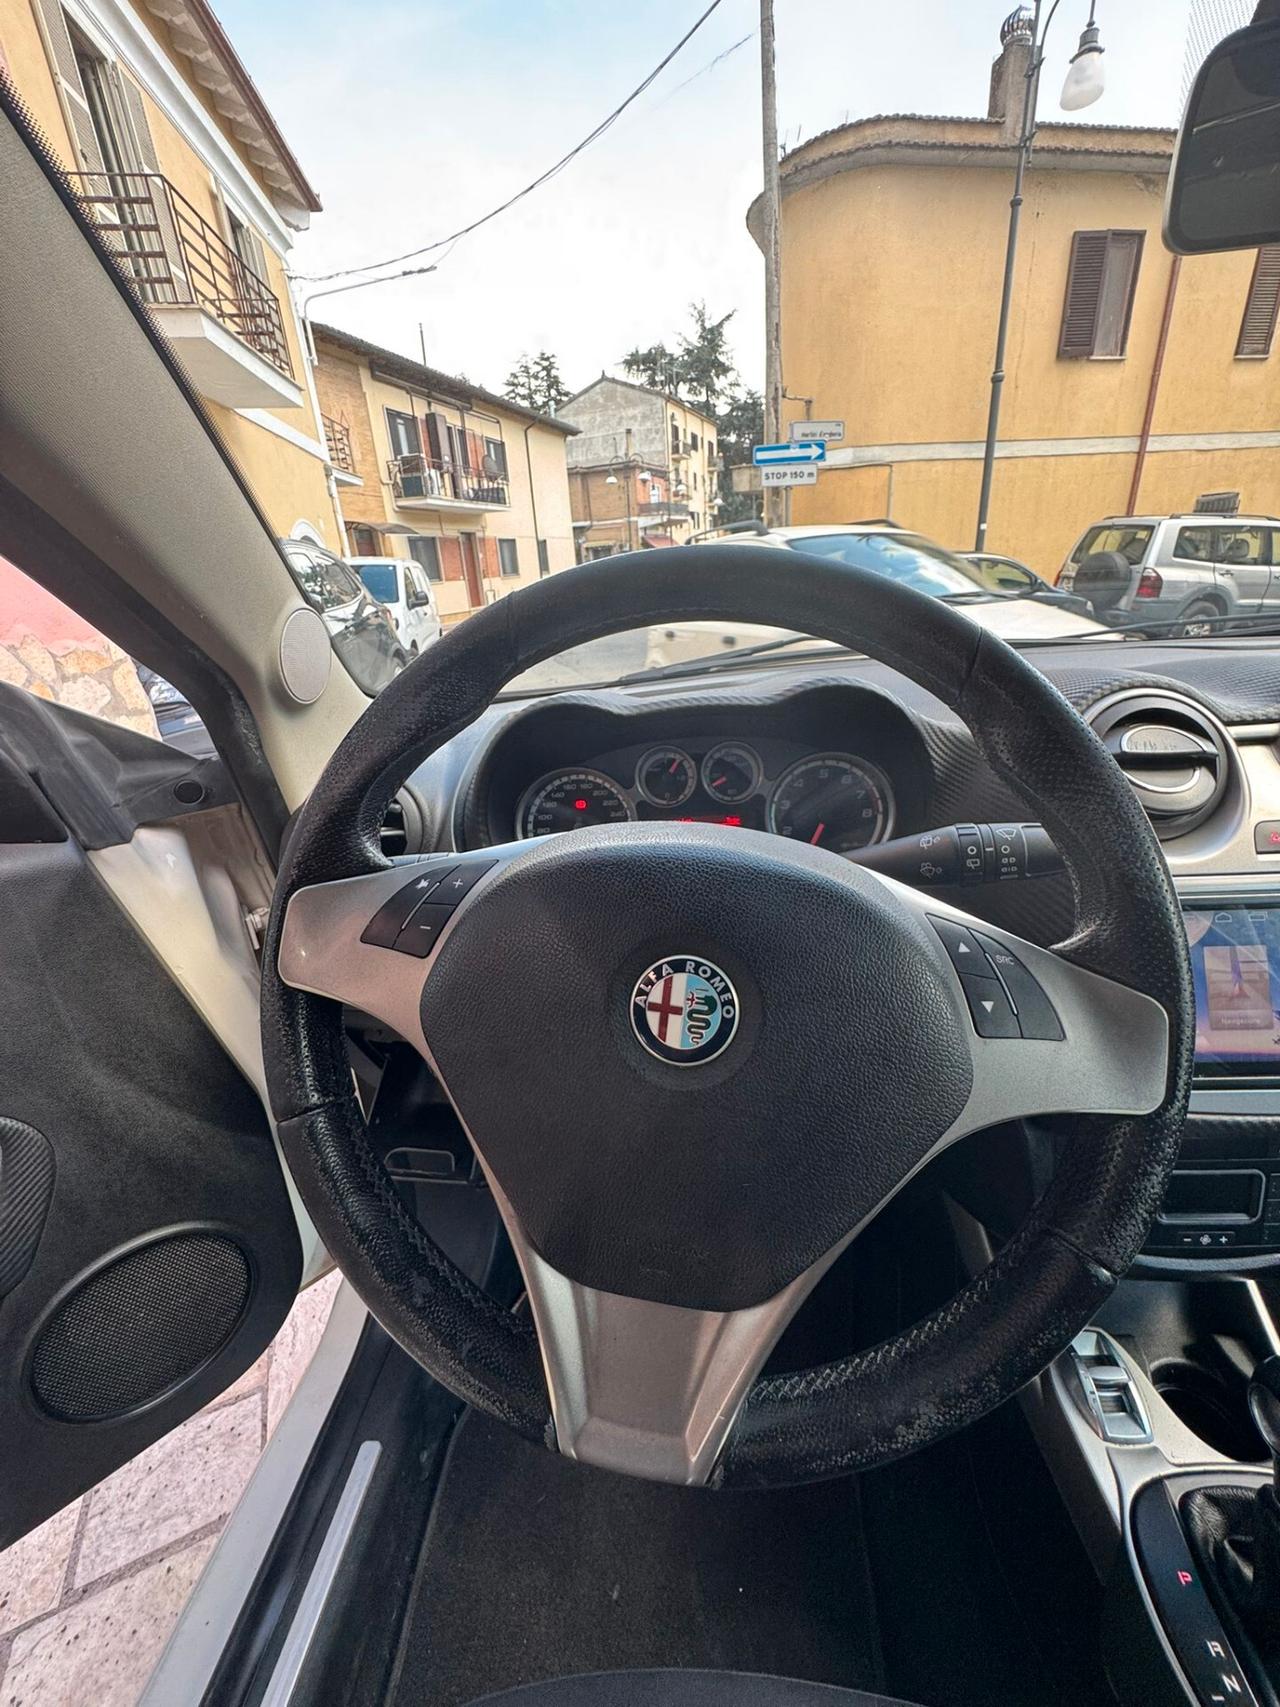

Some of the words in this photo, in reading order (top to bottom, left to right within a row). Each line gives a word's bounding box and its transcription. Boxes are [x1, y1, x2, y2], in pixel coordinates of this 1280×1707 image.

[764, 471, 788, 480] STOP
[790, 471, 805, 479] 150
[819, 769, 829, 778] 5
[856, 790, 866, 799] 7
[780, 800, 791, 810] 3
[782, 826, 793, 835] 2
[995, 954, 1014, 966] SRC
[635, 963, 674, 1009] ALFA
[685, 960, 735, 1019] ROMEO
[1177, 1570, 1193, 1587] P
[1205, 1640, 1226, 1658] R
[1221, 1674, 1241, 1693] N
